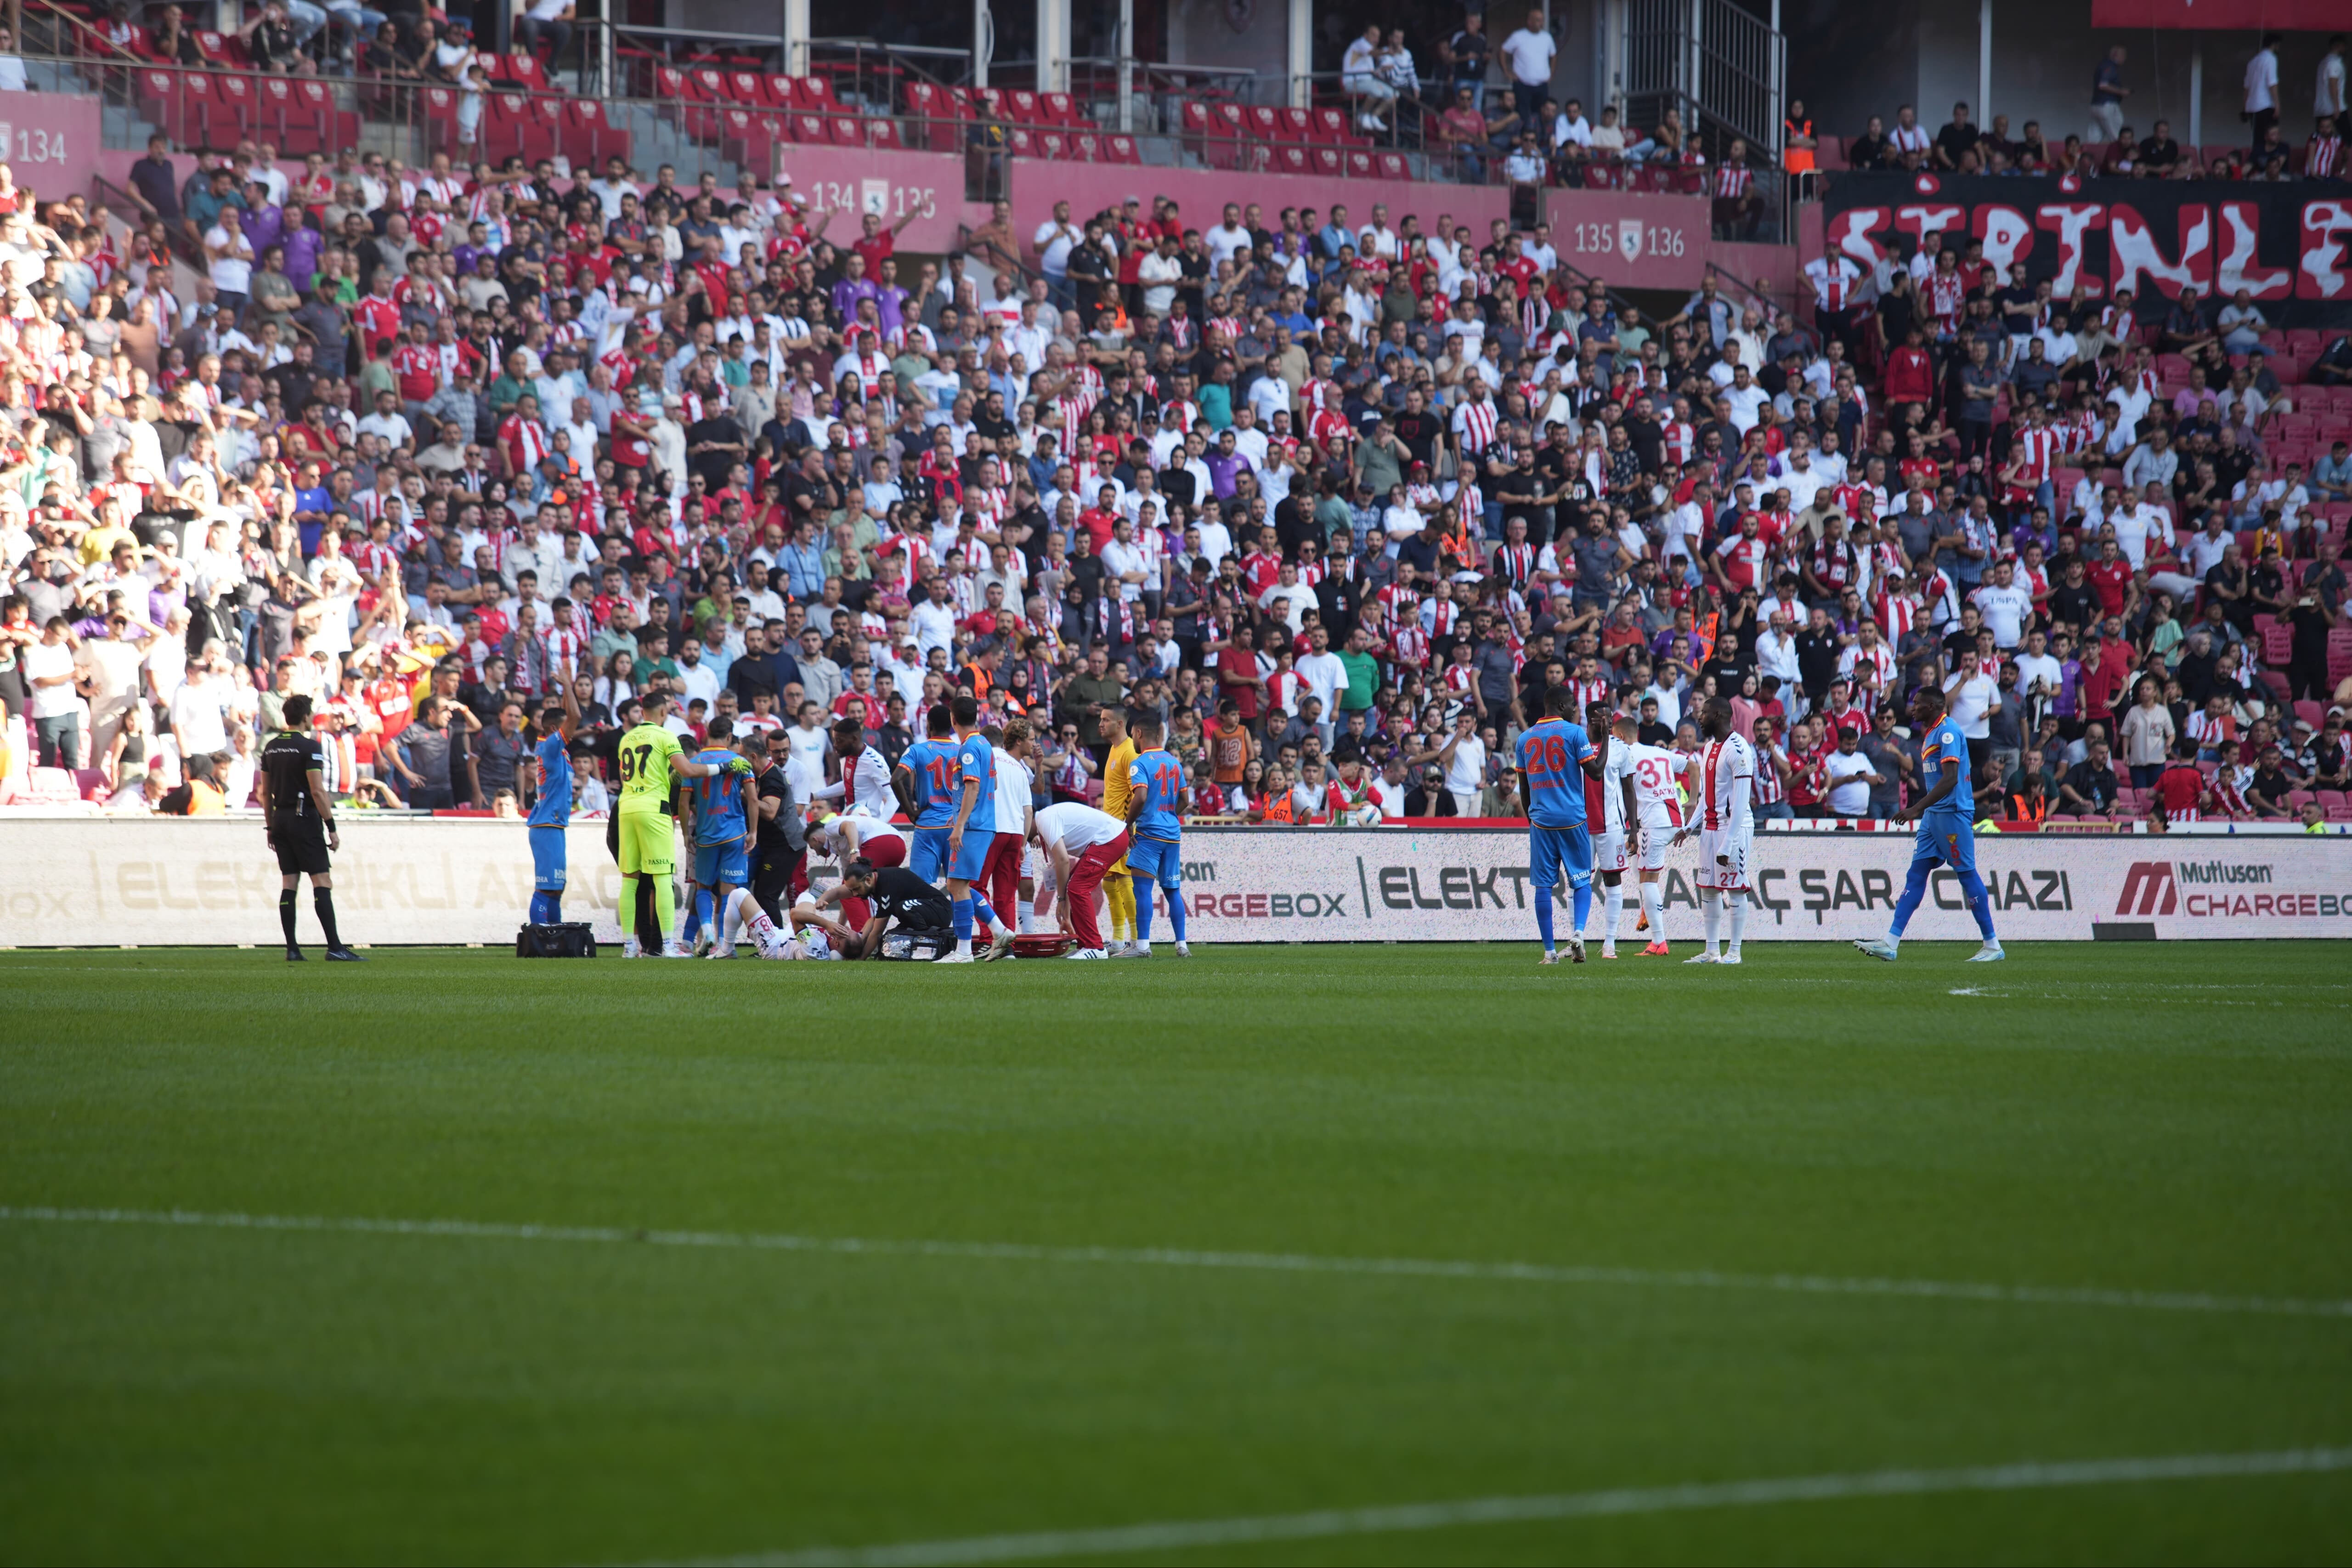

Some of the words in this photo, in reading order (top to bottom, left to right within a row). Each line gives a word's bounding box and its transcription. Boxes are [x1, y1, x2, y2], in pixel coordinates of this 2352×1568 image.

[17, 129, 68, 165] 134
[812, 181, 855, 214] 134
[893, 186, 936, 219] 135
[1575, 222, 1613, 253] 135
[1647, 226, 1685, 258] 136
[622, 744, 653, 782] 97
[1221, 737, 1242, 766] 42
[1525, 735, 1566, 774] 26
[1154, 763, 1179, 797] 11
[1532, 779, 1565, 790] BOKELE
[1636, 757, 1672, 788] 37
[1274, 809, 1288, 821] 657
[1617, 855, 1625, 867] 9
[1950, 844, 1960, 859] 5
[1572, 870, 1590, 881] PASHA
[1720, 872, 1737, 887] 27
[2180, 860, 2272, 883] Mutlusan
[0, 892, 74, 919] OX
[1799, 869, 1918, 925] ŞAR
[1931, 870, 2073, 911] CHAZI
